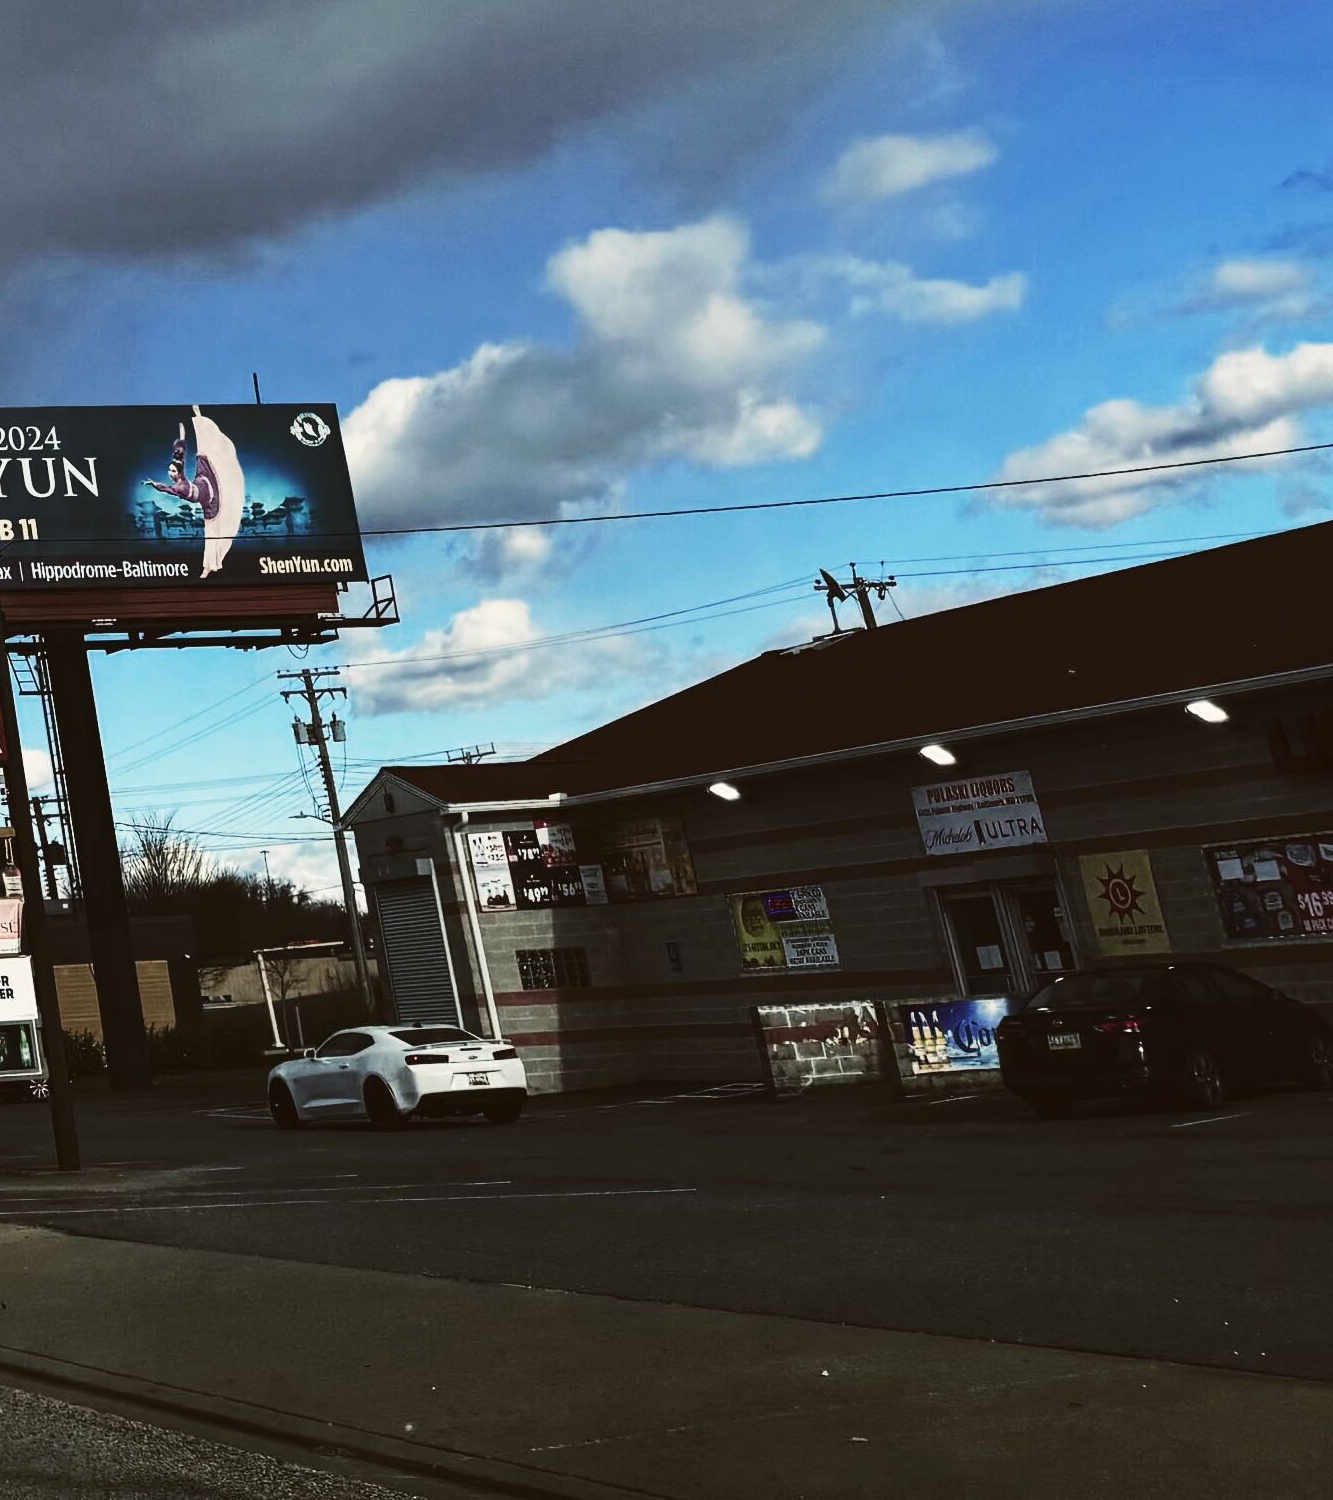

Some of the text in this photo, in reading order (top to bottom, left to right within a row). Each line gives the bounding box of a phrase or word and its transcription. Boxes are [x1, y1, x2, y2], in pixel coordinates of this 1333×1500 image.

[19, 518, 39, 540] 11
[30, 560, 189, 582] Hippodrome-Baltimore
[259, 555, 353, 574] ShenYun.com
[926, 777, 1015, 804] PULASKI LIQUORS
[985, 816, 1043, 840] ULTRA
